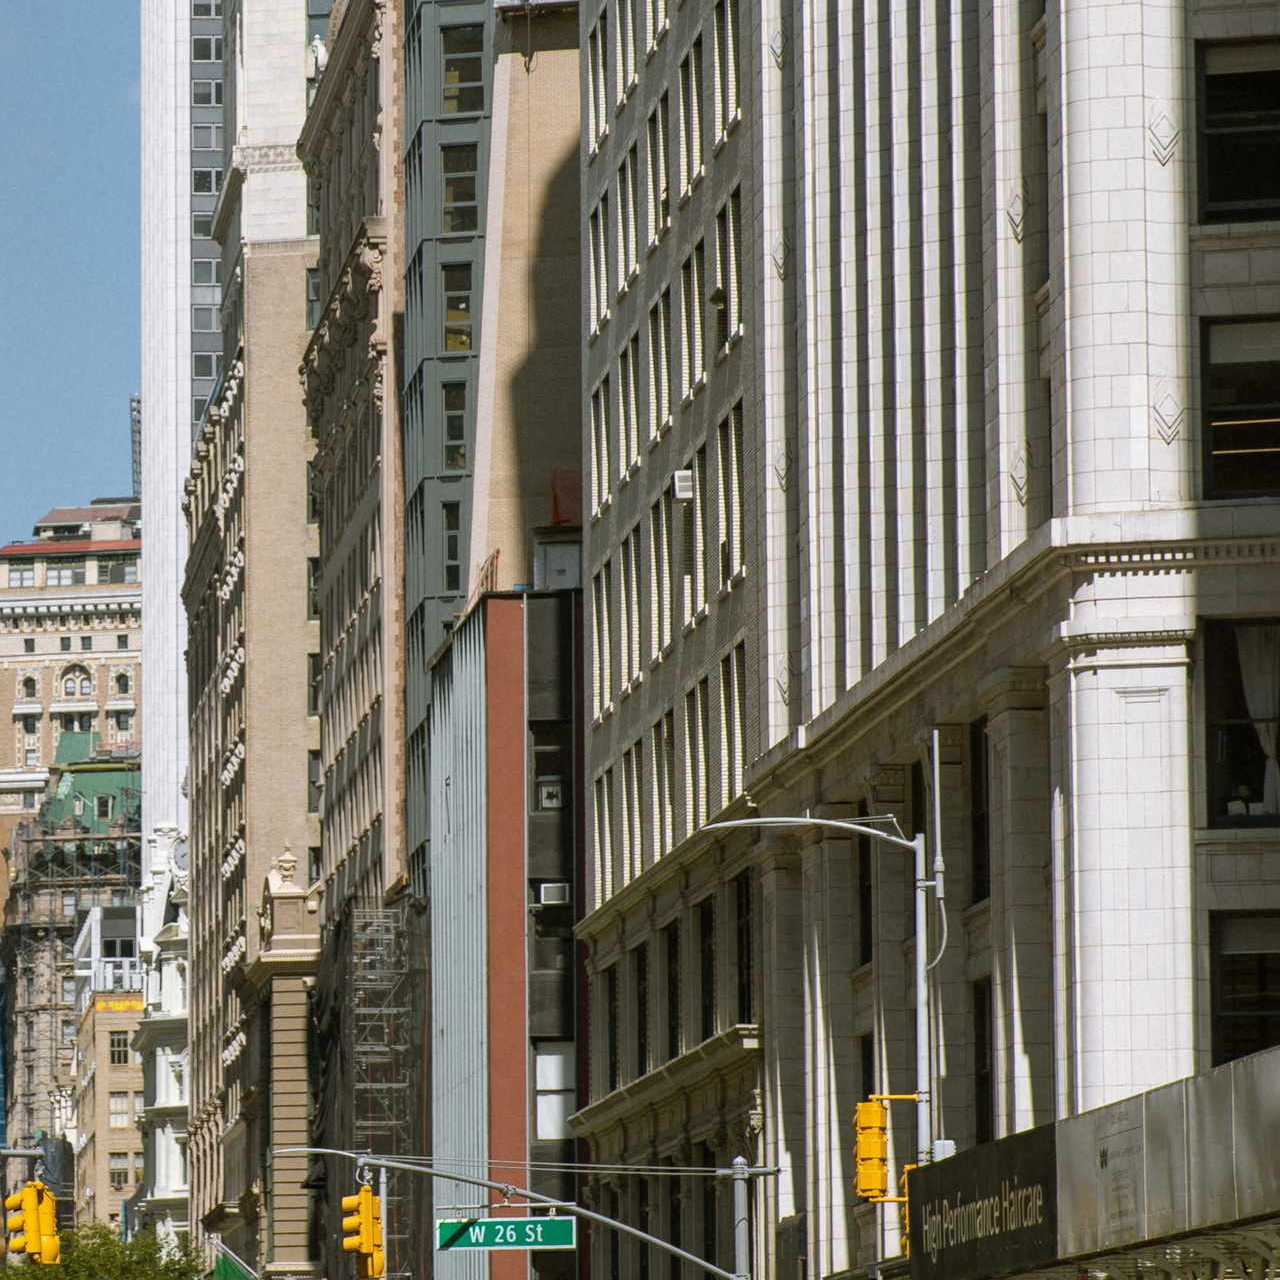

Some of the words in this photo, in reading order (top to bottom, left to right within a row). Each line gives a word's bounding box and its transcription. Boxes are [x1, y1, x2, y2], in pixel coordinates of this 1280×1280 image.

[470, 1225, 485, 1243] W
[494, 1225, 516, 1242] 26
[525, 1223, 543, 1242] St
[922, 1199, 942, 1263] High
[943, 1191, 1000, 1246] Performance
[1001, 1175, 1043, 1232] Haircare
